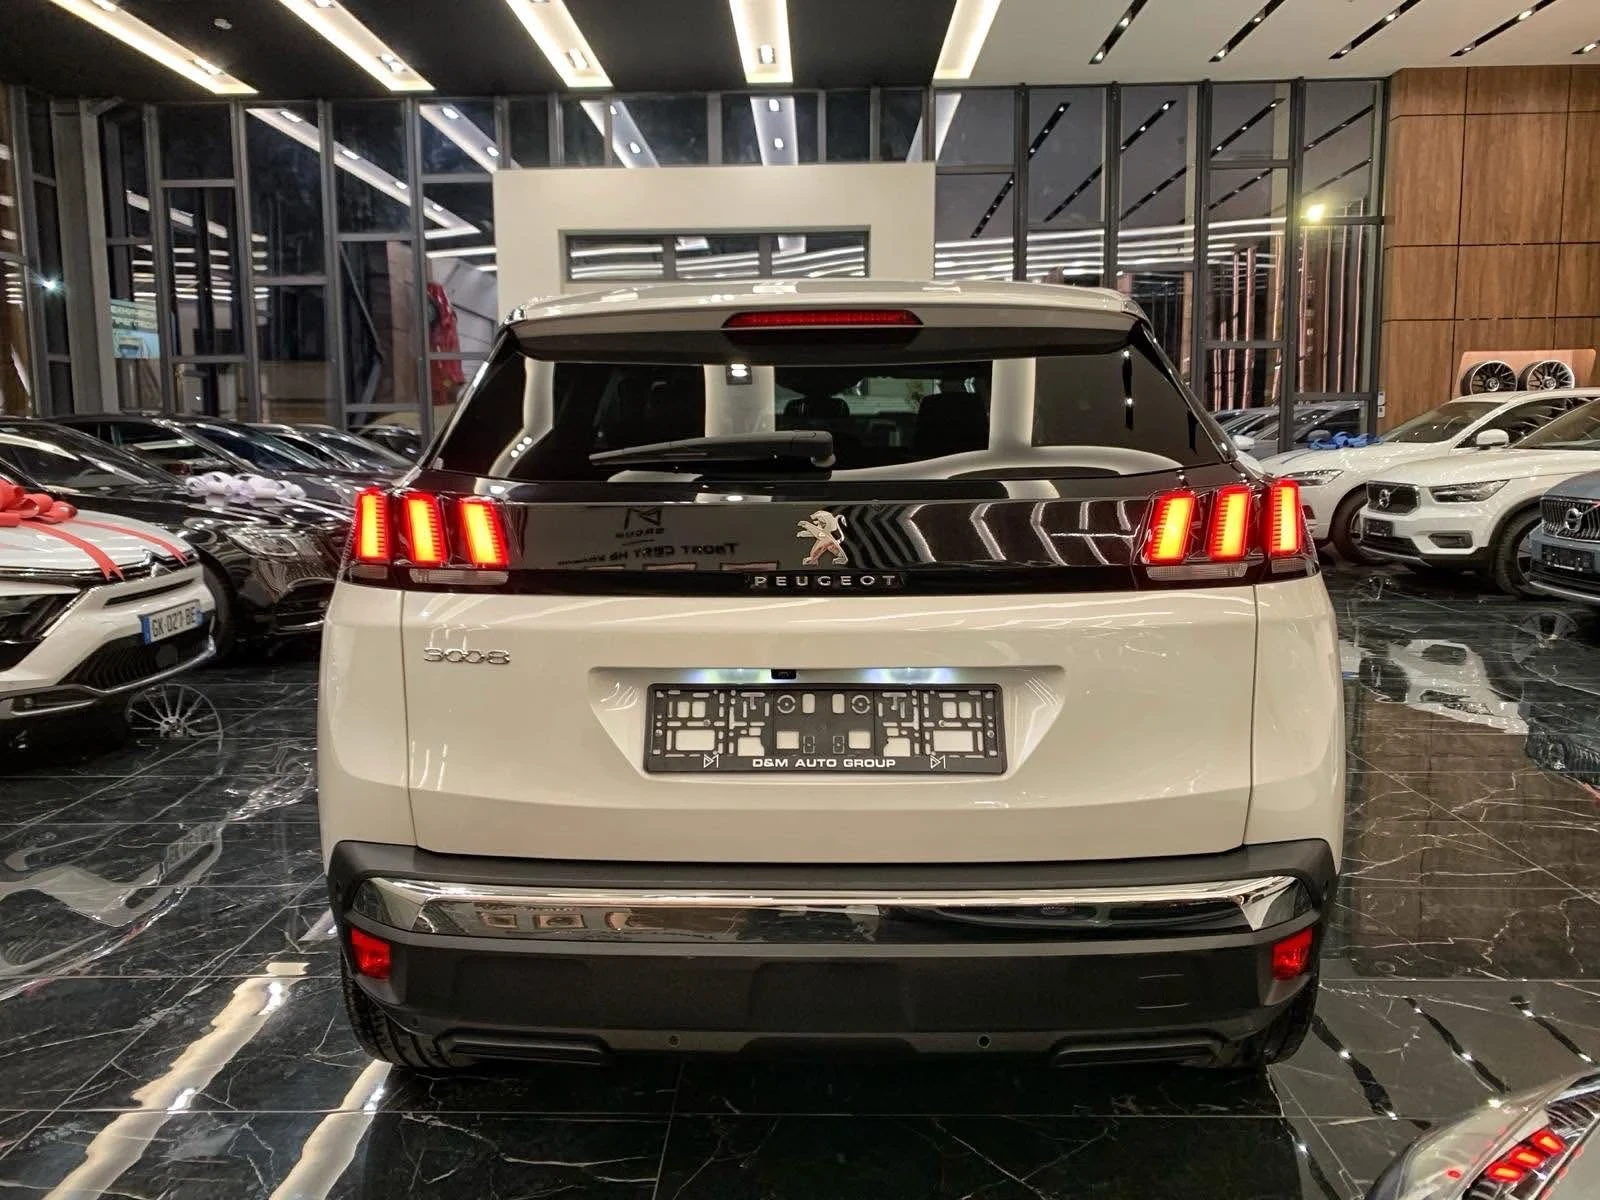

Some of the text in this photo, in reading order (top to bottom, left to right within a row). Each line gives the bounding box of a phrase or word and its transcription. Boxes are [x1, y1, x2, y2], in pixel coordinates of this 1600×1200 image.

[754, 575, 896, 587] PEUGEOT
[424, 648, 510, 665] 3008
[752, 758, 896, 768] D&M AUTO GROUP
